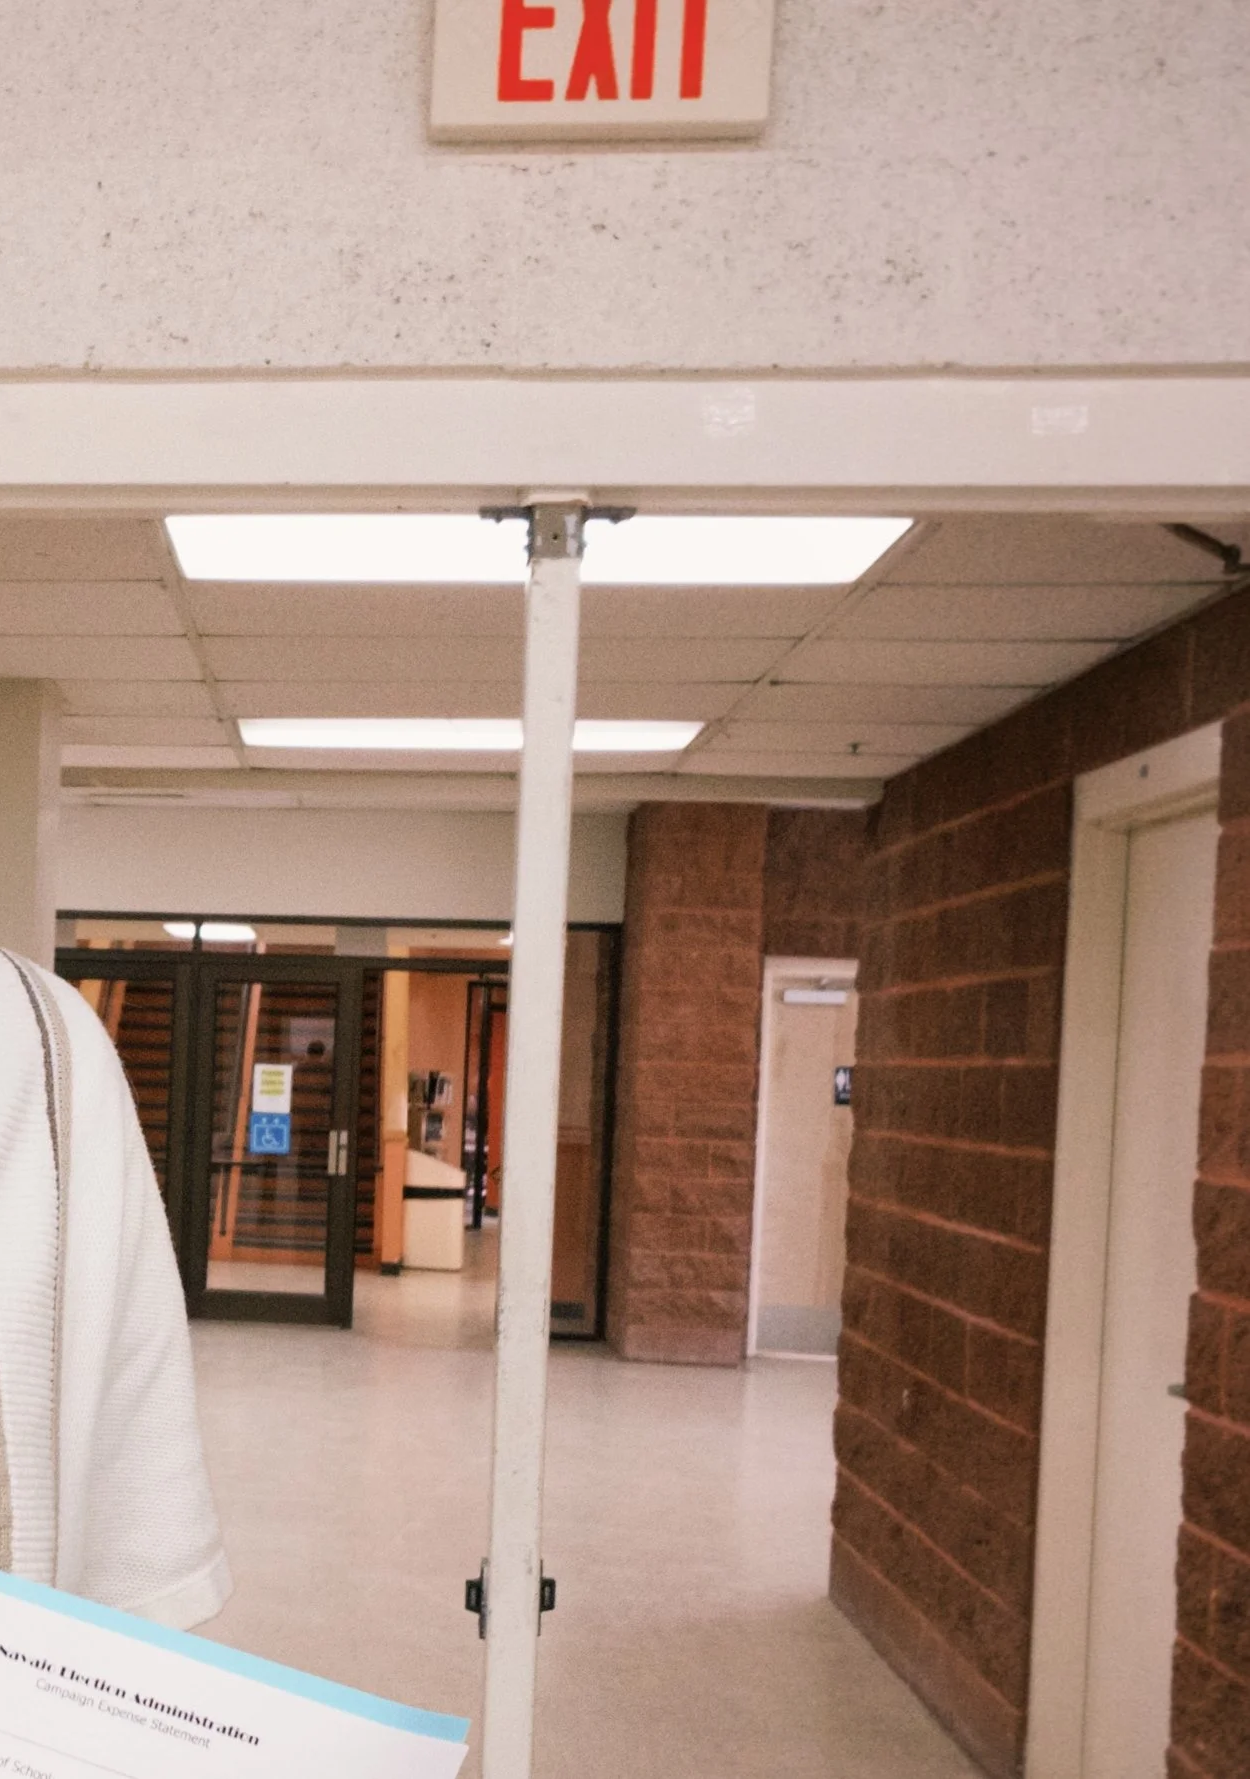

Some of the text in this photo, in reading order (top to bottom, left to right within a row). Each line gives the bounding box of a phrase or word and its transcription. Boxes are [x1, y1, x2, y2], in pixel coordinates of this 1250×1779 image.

[36, 1677, 211, 1749] Campaign Expense Statement
[59, 1666, 127, 1699] Election
[128, 1692, 260, 1747] Administration
